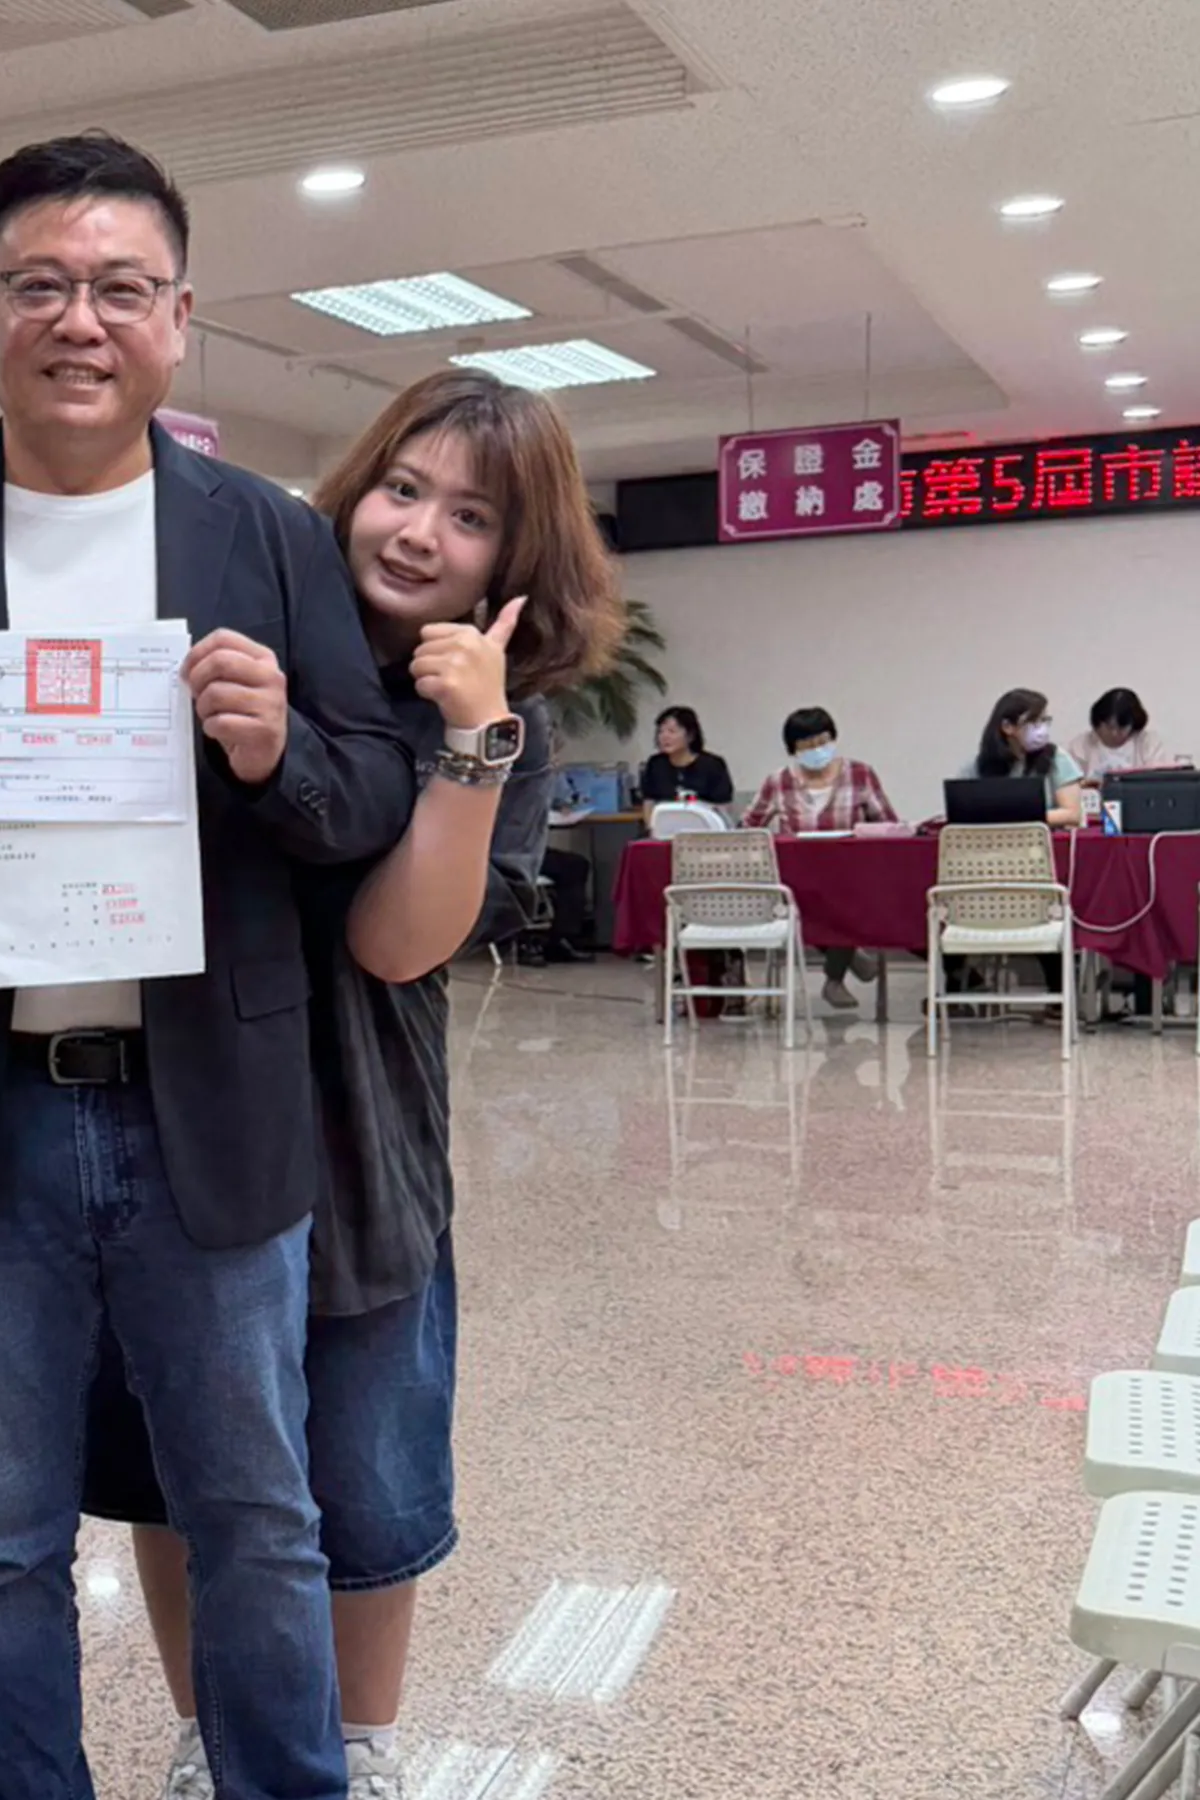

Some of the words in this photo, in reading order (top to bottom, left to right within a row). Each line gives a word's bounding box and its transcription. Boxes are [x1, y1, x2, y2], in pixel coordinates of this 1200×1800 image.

[738, 438, 883, 480] 保證金
[737, 480, 884, 522] 繳納處
